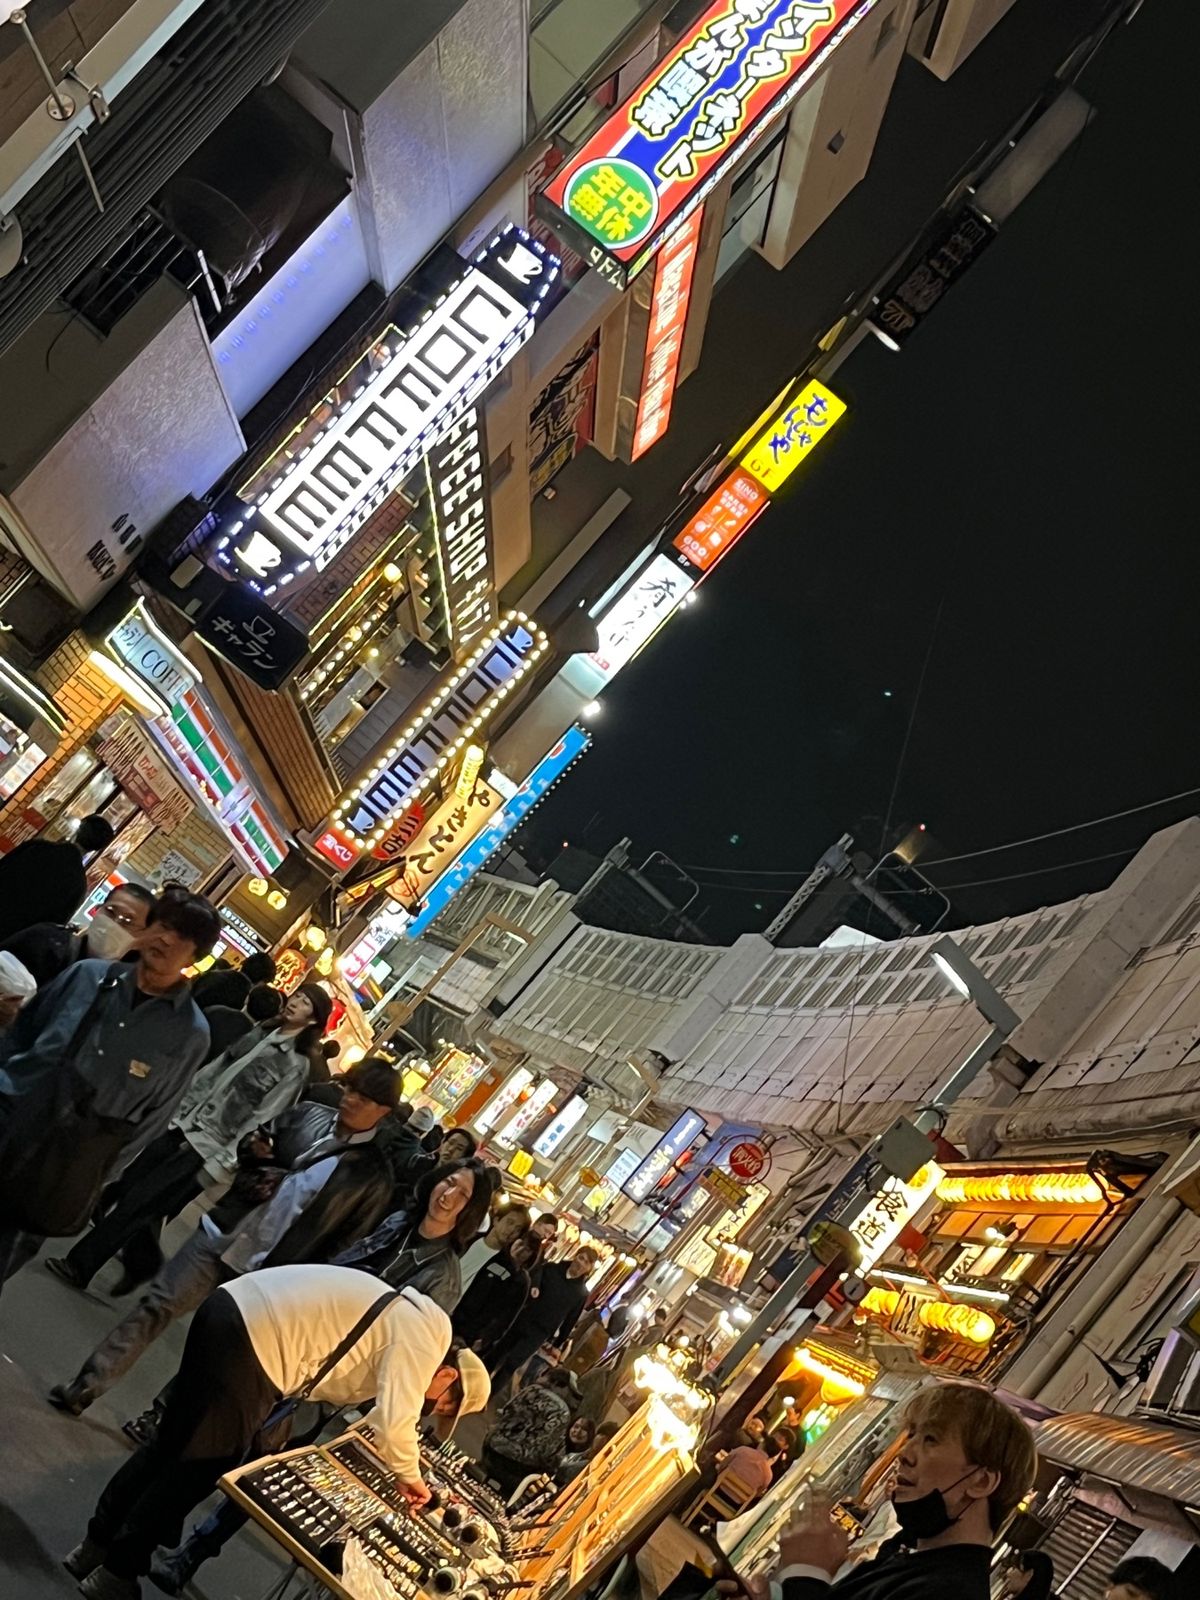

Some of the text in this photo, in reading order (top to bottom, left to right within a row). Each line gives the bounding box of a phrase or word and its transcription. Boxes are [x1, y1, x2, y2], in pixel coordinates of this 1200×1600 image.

[659, 3, 834, 178] インターネット
[570, 183, 633, 240] 無休
[590, 165, 652, 218] 年中
[649, 324, 680, 386] Coffee
[274, 284, 512, 540] COFFEE
[443, 499, 486, 585] SHOP
[207, 612, 279, 675] ギャラン
[363, 645, 517, 816] COFFEE
[380, 813, 420, 855] 三吉
[408, 789, 491, 873] やきとん
[731, 1145, 761, 1174] 消火栓
